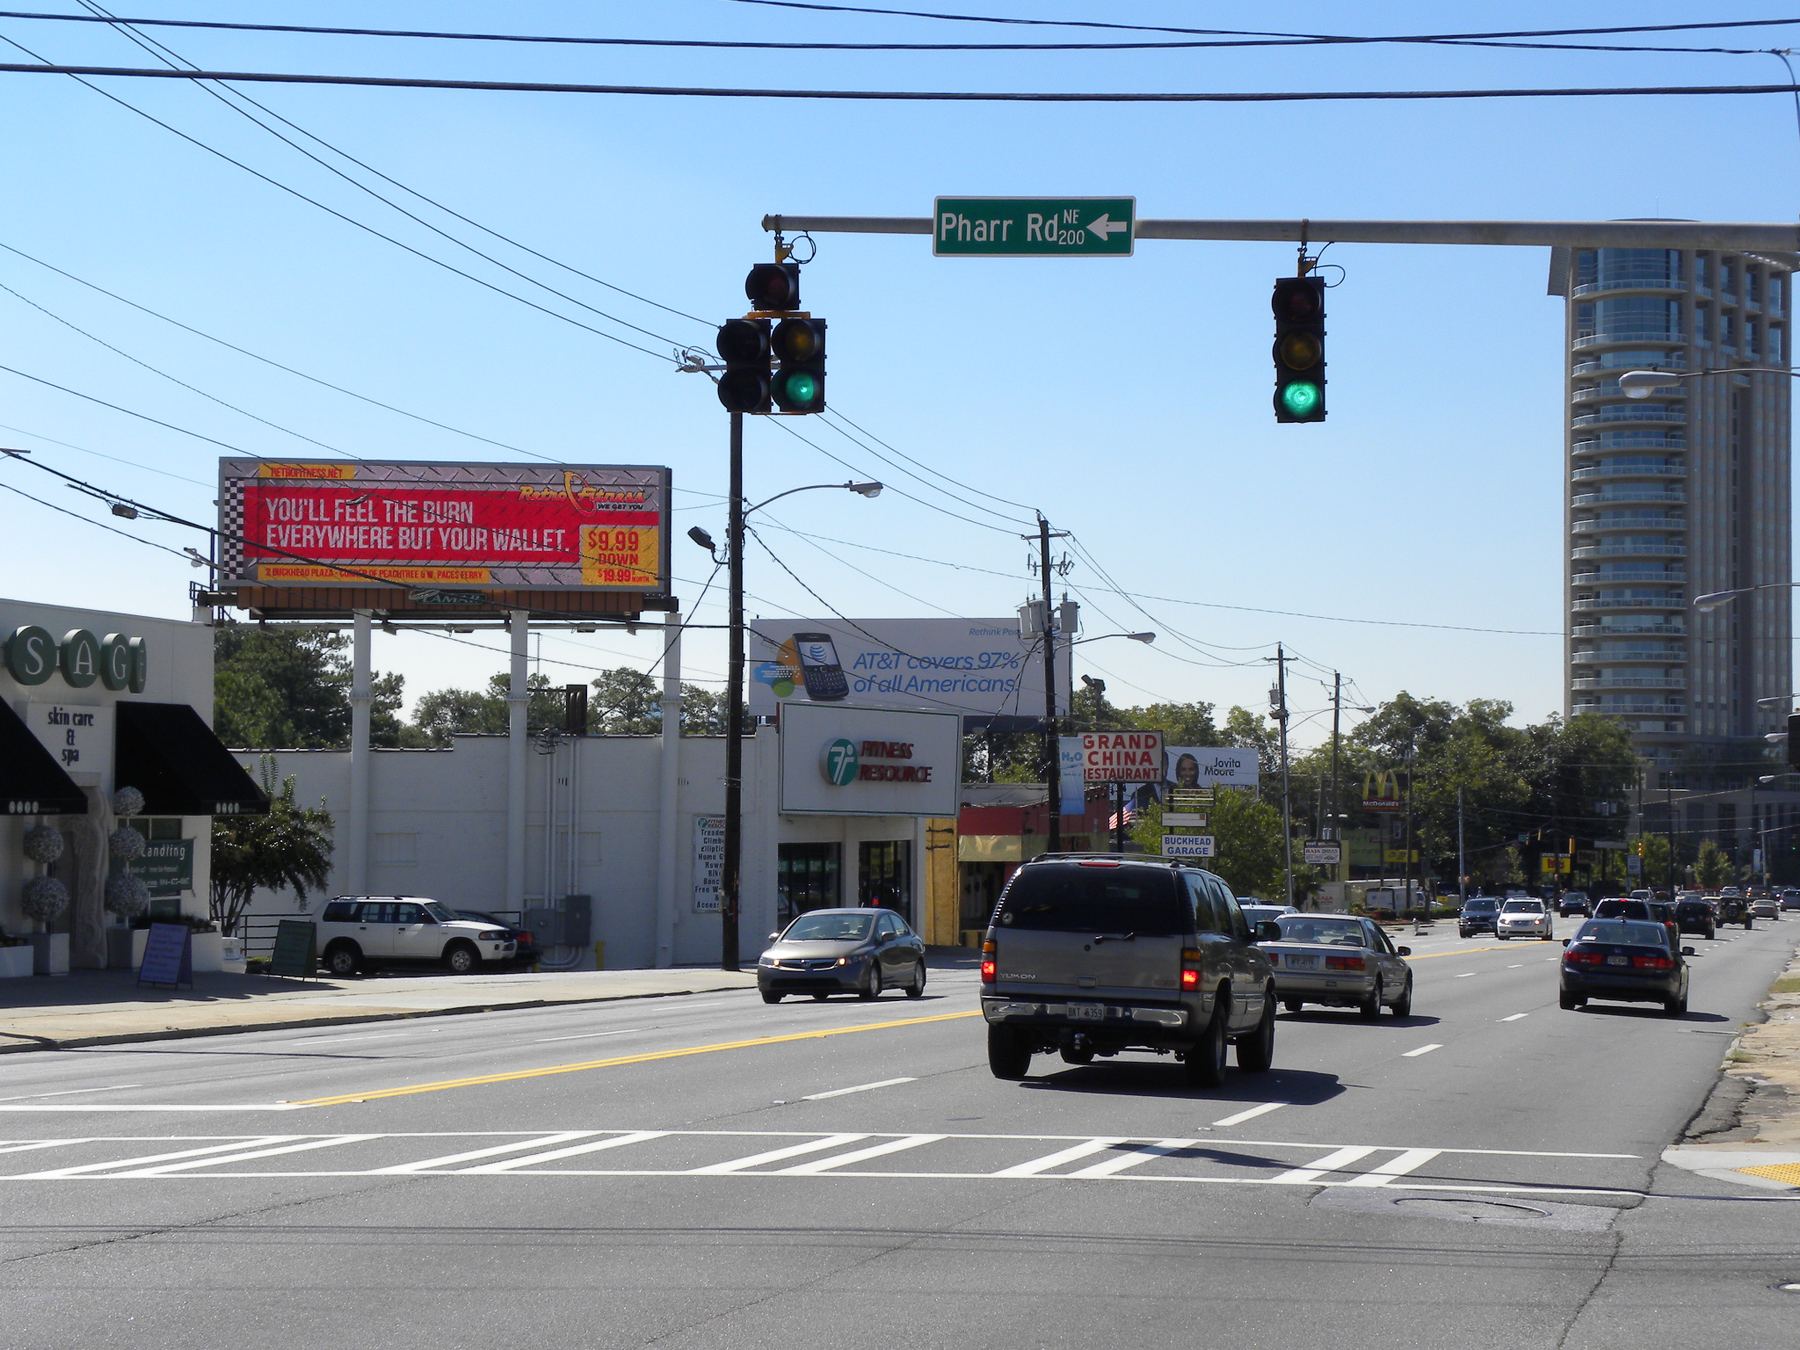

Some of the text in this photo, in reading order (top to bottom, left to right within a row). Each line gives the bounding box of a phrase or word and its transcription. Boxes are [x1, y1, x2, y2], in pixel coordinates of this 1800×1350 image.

[1063, 209, 1080, 224] NE
[941, 212, 1058, 242] Pharr Rd
[1058, 230, 1085, 245] 200
[265, 498, 473, 524] YOU'LL FEEL THE BURN
[266, 524, 570, 552] EVERYWHERE BUT YOUR WALLET.
[588, 531, 639, 551] $9.99
[598, 553, 639, 566] DOWN
[25, 636, 145, 682] SAGE
[853, 652, 1019, 670] AT&T covers 97%
[853, 675, 878, 692] of
[878, 675, 903, 692] all
[48, 706, 94, 726] skin care
[66, 728, 75, 745] &
[1083, 735, 1158, 749] GRAND
[62, 749, 79, 766] spa
[860, 740, 914, 759] FITNESS
[1087, 751, 1154, 766] CHINA
[1213, 757, 1240, 768] Jovita
[859, 764, 933, 782] RESOURCE
[1204, 766, 1235, 776] Moore
[1164, 837, 1211, 846] BUCKHEAD
[1167, 847, 1209, 855] GARAGE
